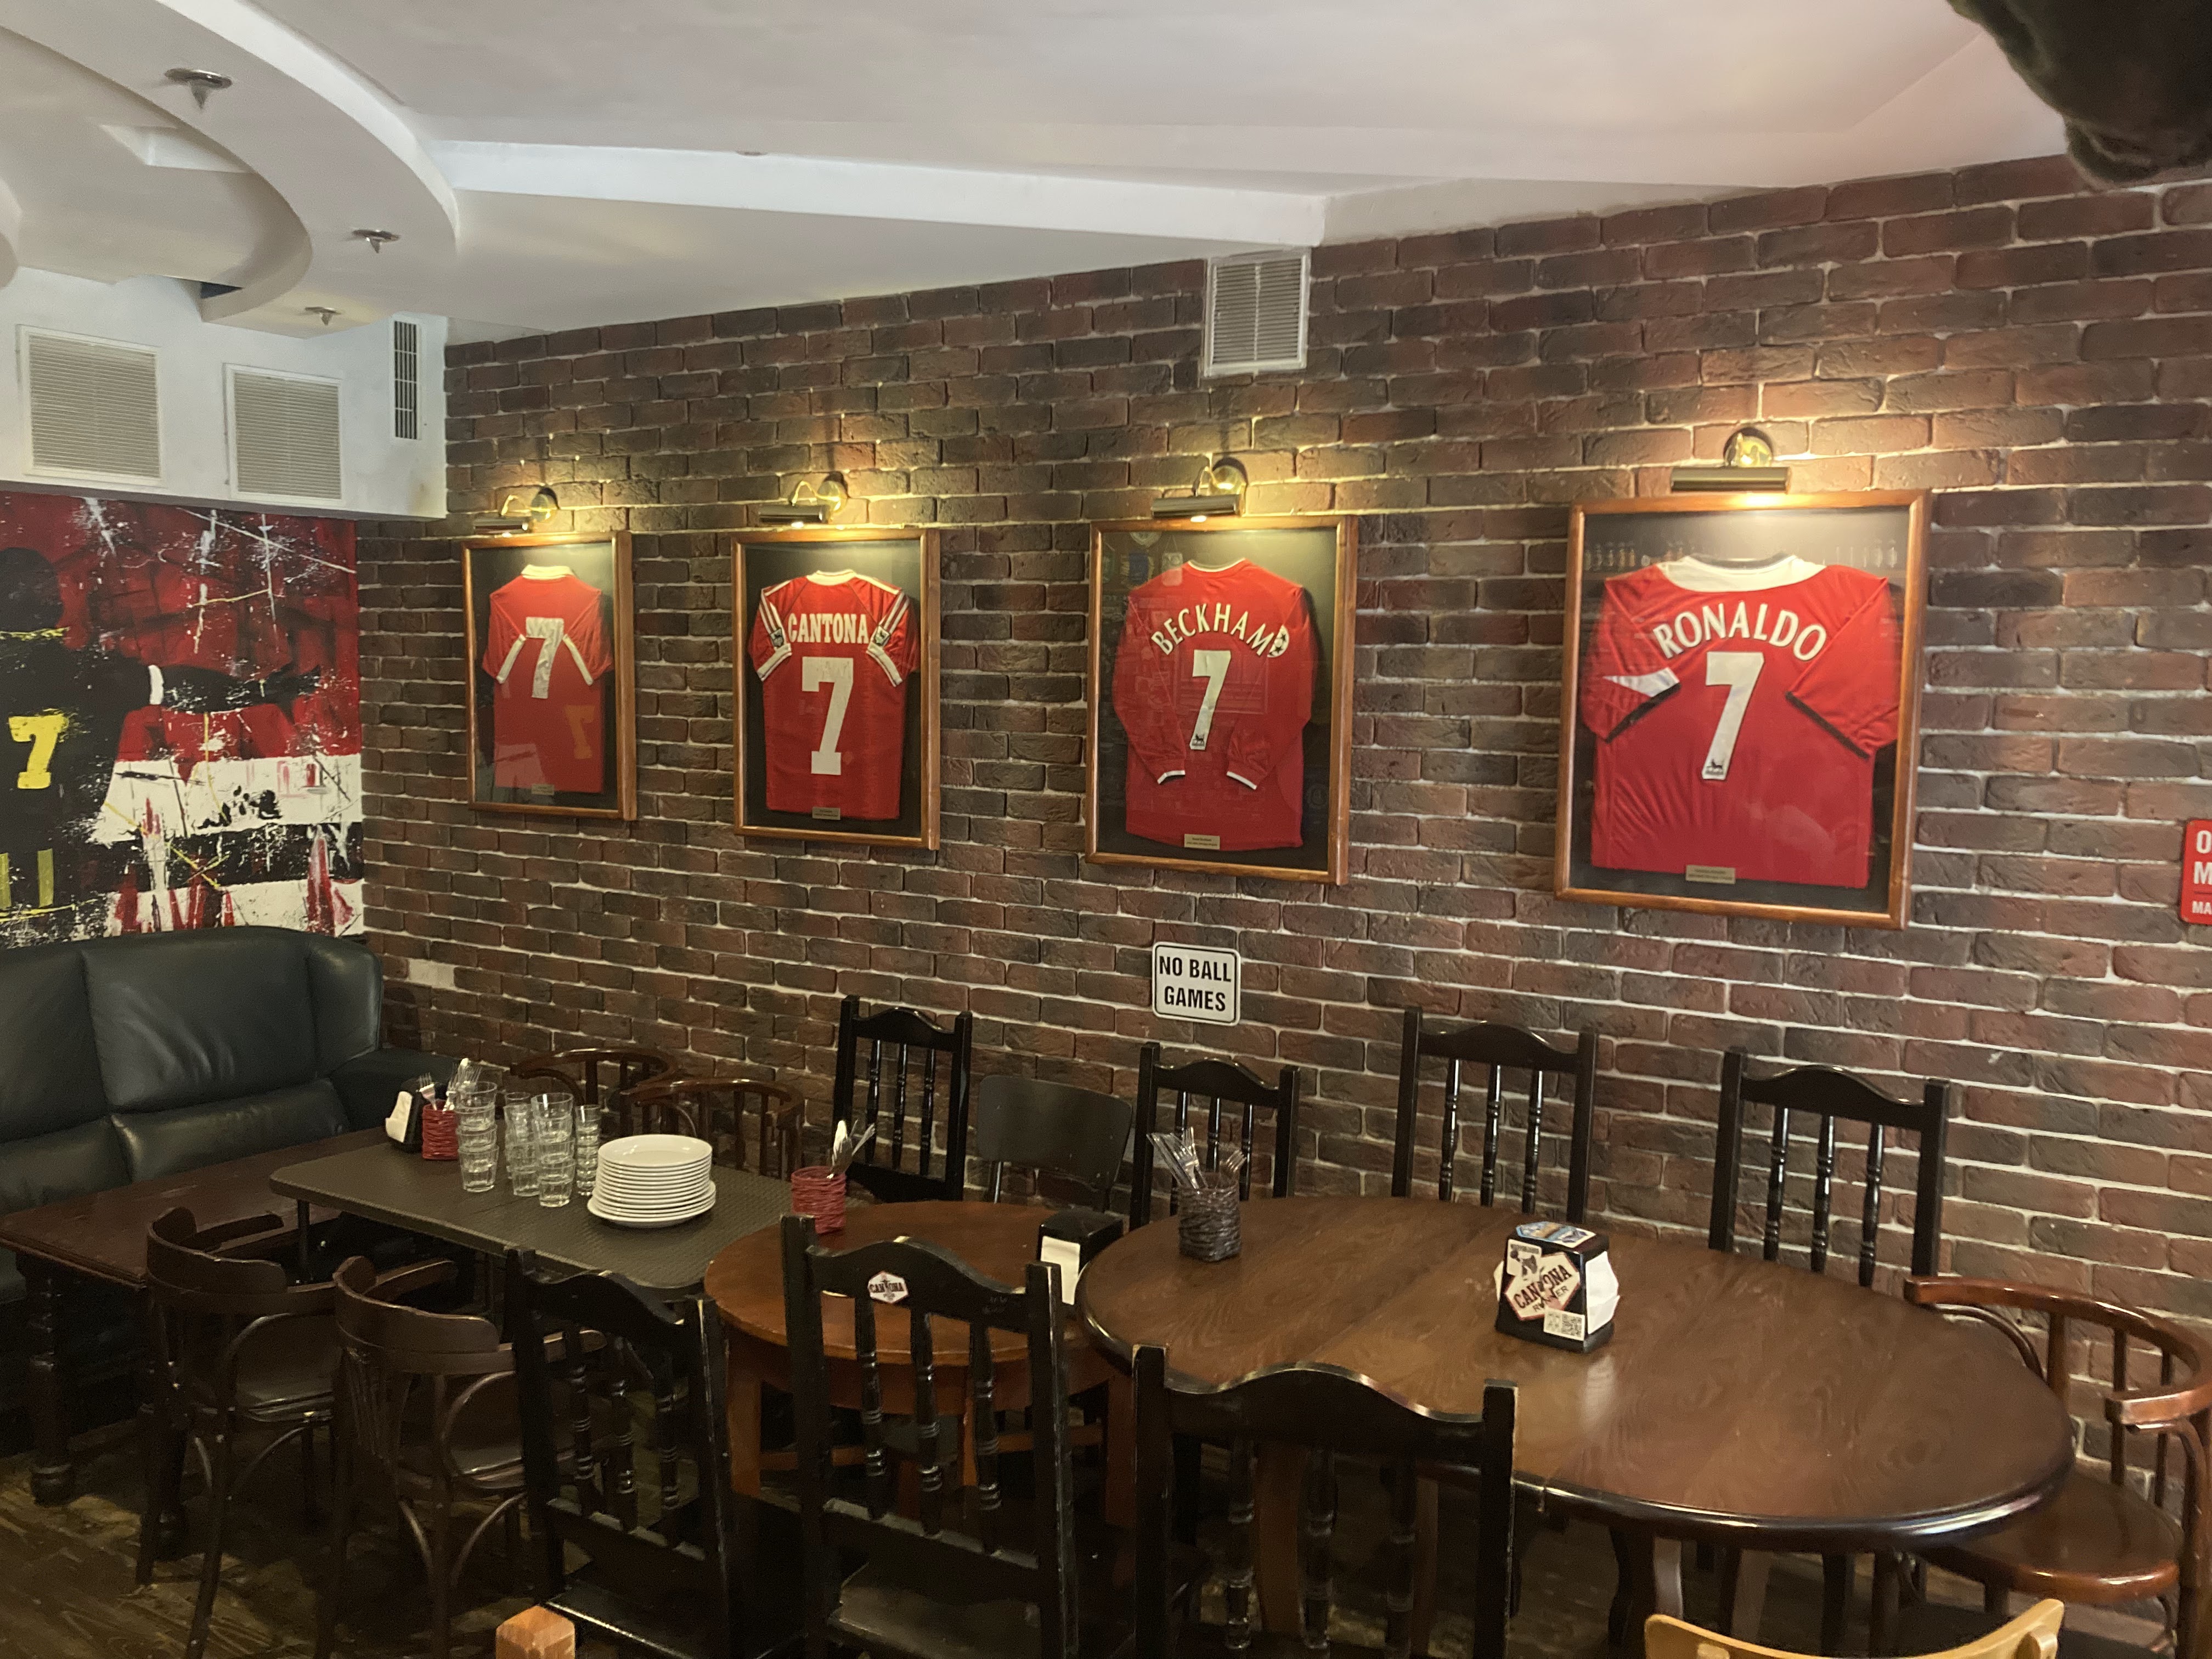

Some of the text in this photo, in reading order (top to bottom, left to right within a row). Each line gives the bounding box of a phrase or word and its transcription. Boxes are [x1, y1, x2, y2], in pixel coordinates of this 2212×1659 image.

[525, 617, 565, 699] 7
[788, 613, 869, 644] CANTONA
[1151, 602, 1274, 656] BECKHAM
[1653, 601, 1827, 662] RONALDO
[802, 657, 854, 775] 7
[1189, 650, 1231, 750] 7
[1702, 651, 1764, 780] 7
[8, 714, 68, 789] 7
[1159, 956, 1231, 983] NO BALL
[1164, 986, 1226, 1012] GAMES
[1514, 1265, 1572, 1309] CANONA
